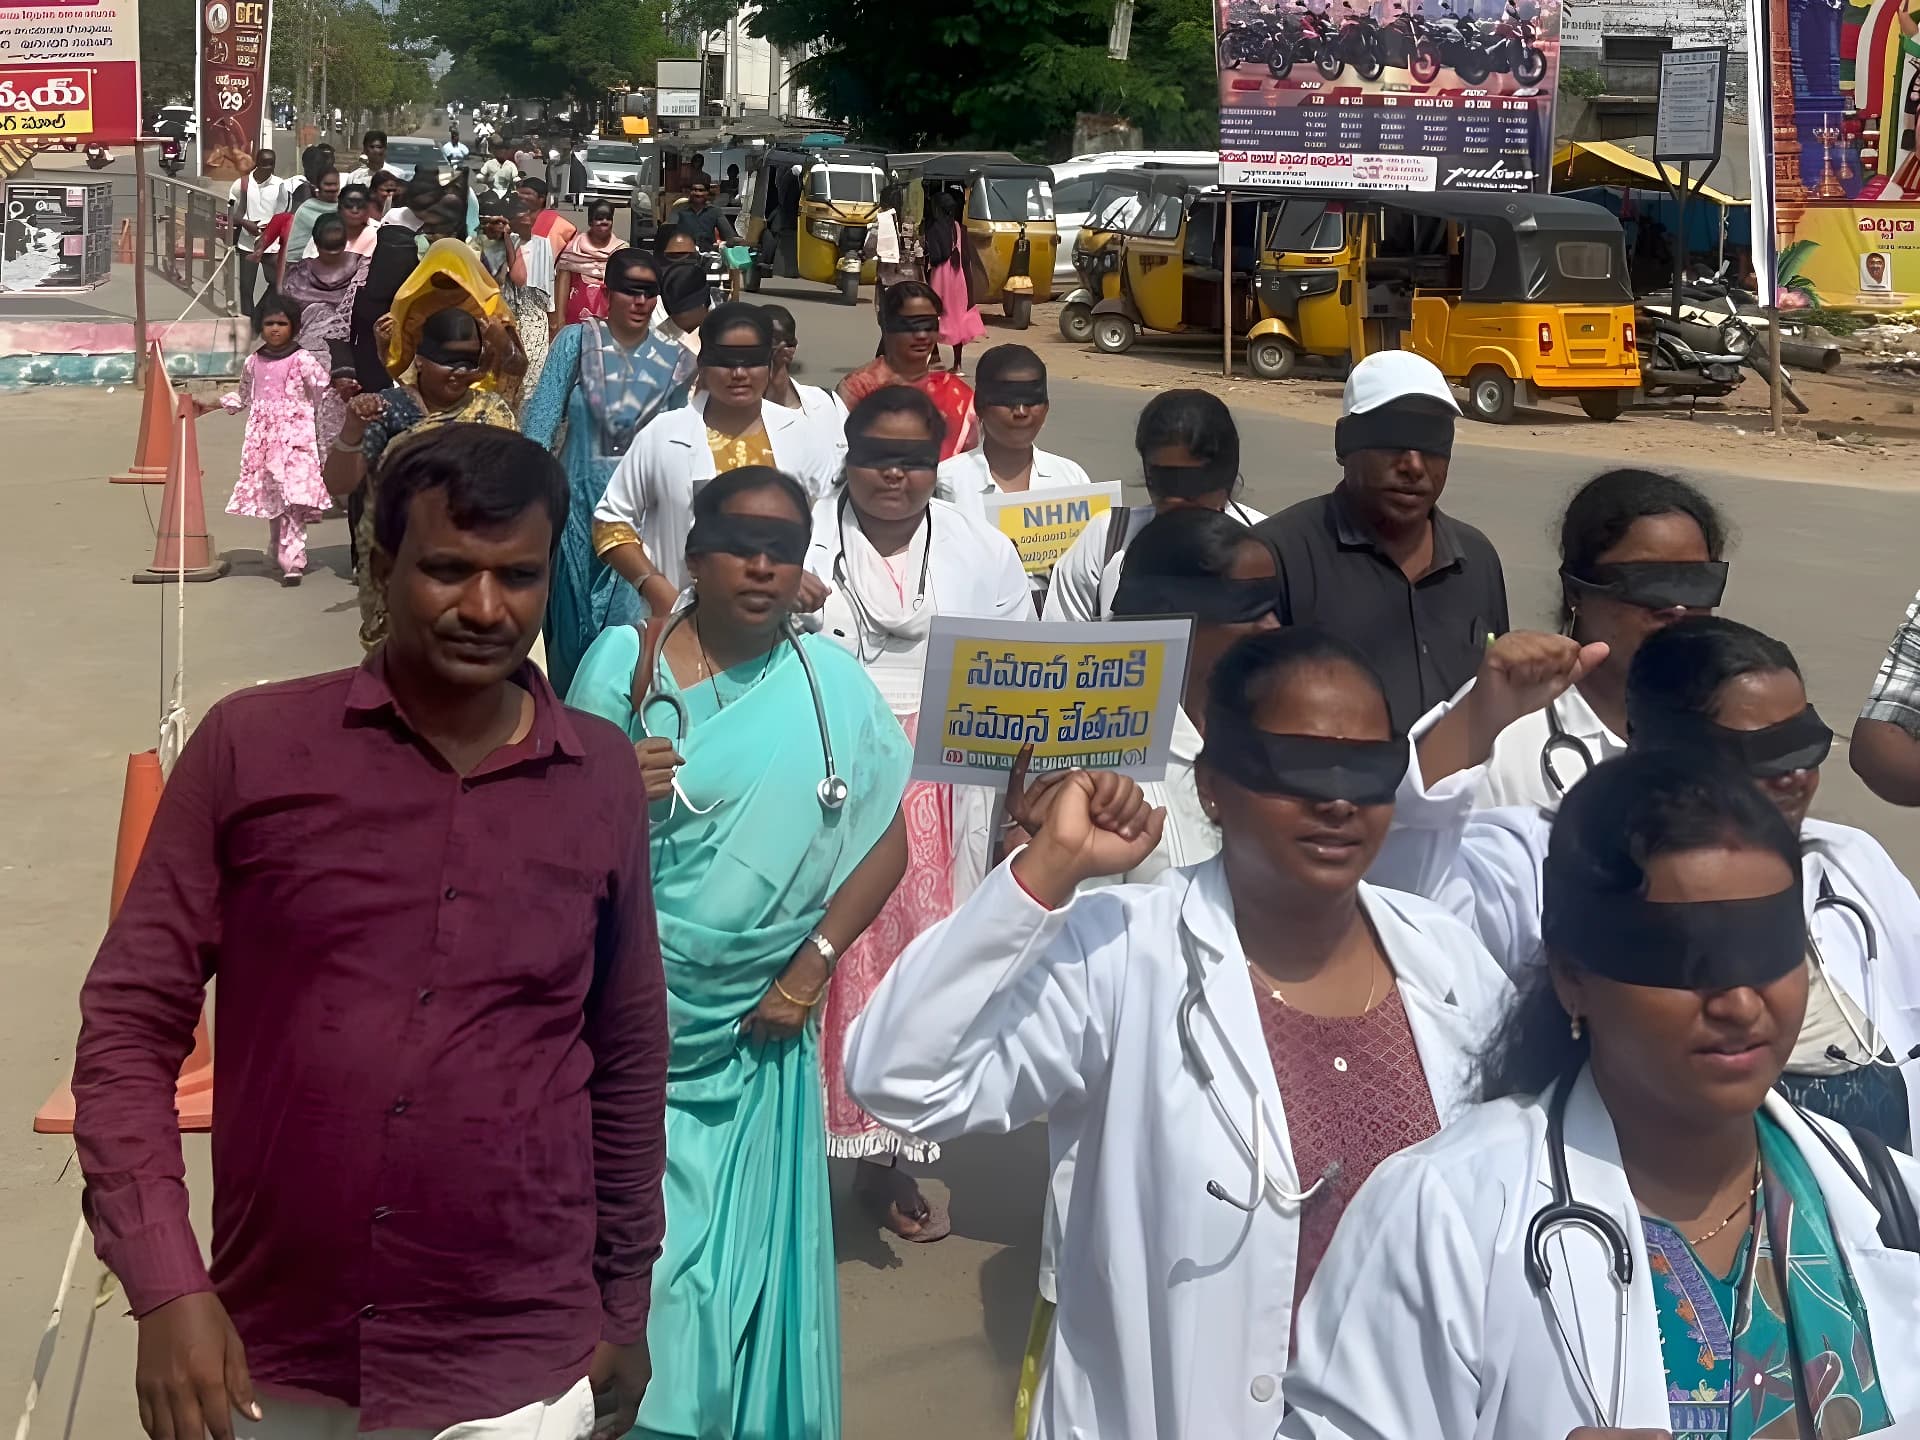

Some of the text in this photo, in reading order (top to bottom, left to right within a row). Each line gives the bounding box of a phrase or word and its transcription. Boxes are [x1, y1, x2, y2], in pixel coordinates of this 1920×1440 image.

[1024, 500, 1090, 528] NHM
[967, 649, 1147, 690] సమాన పనికి
[948, 701, 1149, 743] సమాన వేతనం
